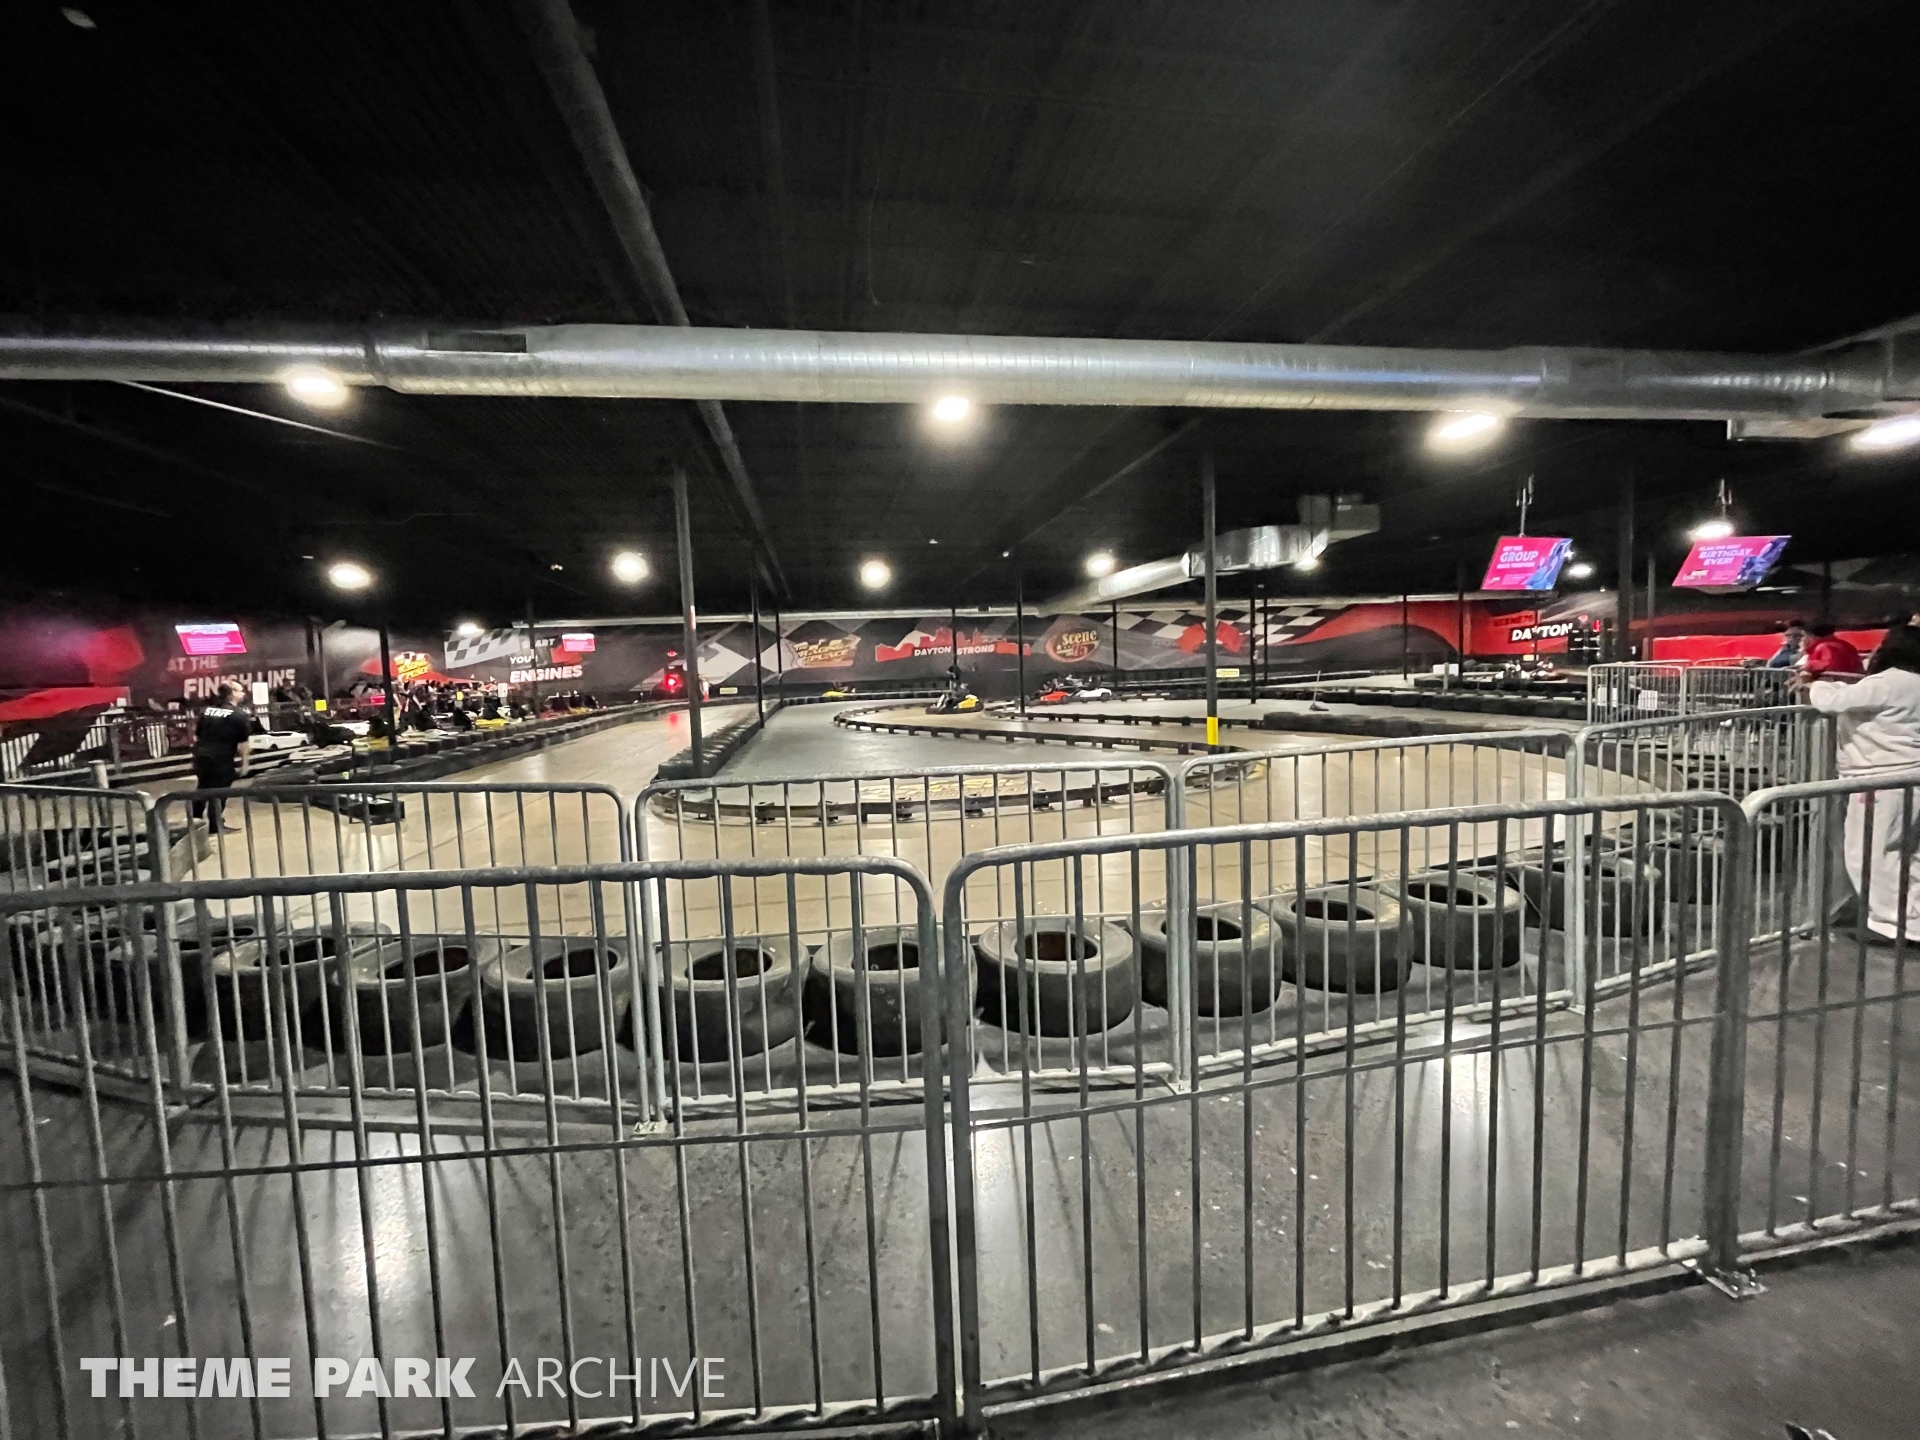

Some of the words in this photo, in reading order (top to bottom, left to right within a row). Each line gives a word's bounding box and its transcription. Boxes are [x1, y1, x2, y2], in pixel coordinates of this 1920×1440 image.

[1500, 551, 1538, 562] GROUP
[1698, 549, 1753, 559] BIRTHDAY
[522, 638, 555, 649] SART
[1061, 630, 1098, 646] Scene
[914, 647, 951, 657] DAYTON
[956, 644, 995, 656] STRONG
[167, 657, 186, 671] AT
[189, 655, 219, 671] THE
[510, 654, 538, 664] YOU
[509, 665, 583, 683] ENGINES
[204, 707, 235, 718] STAFF
